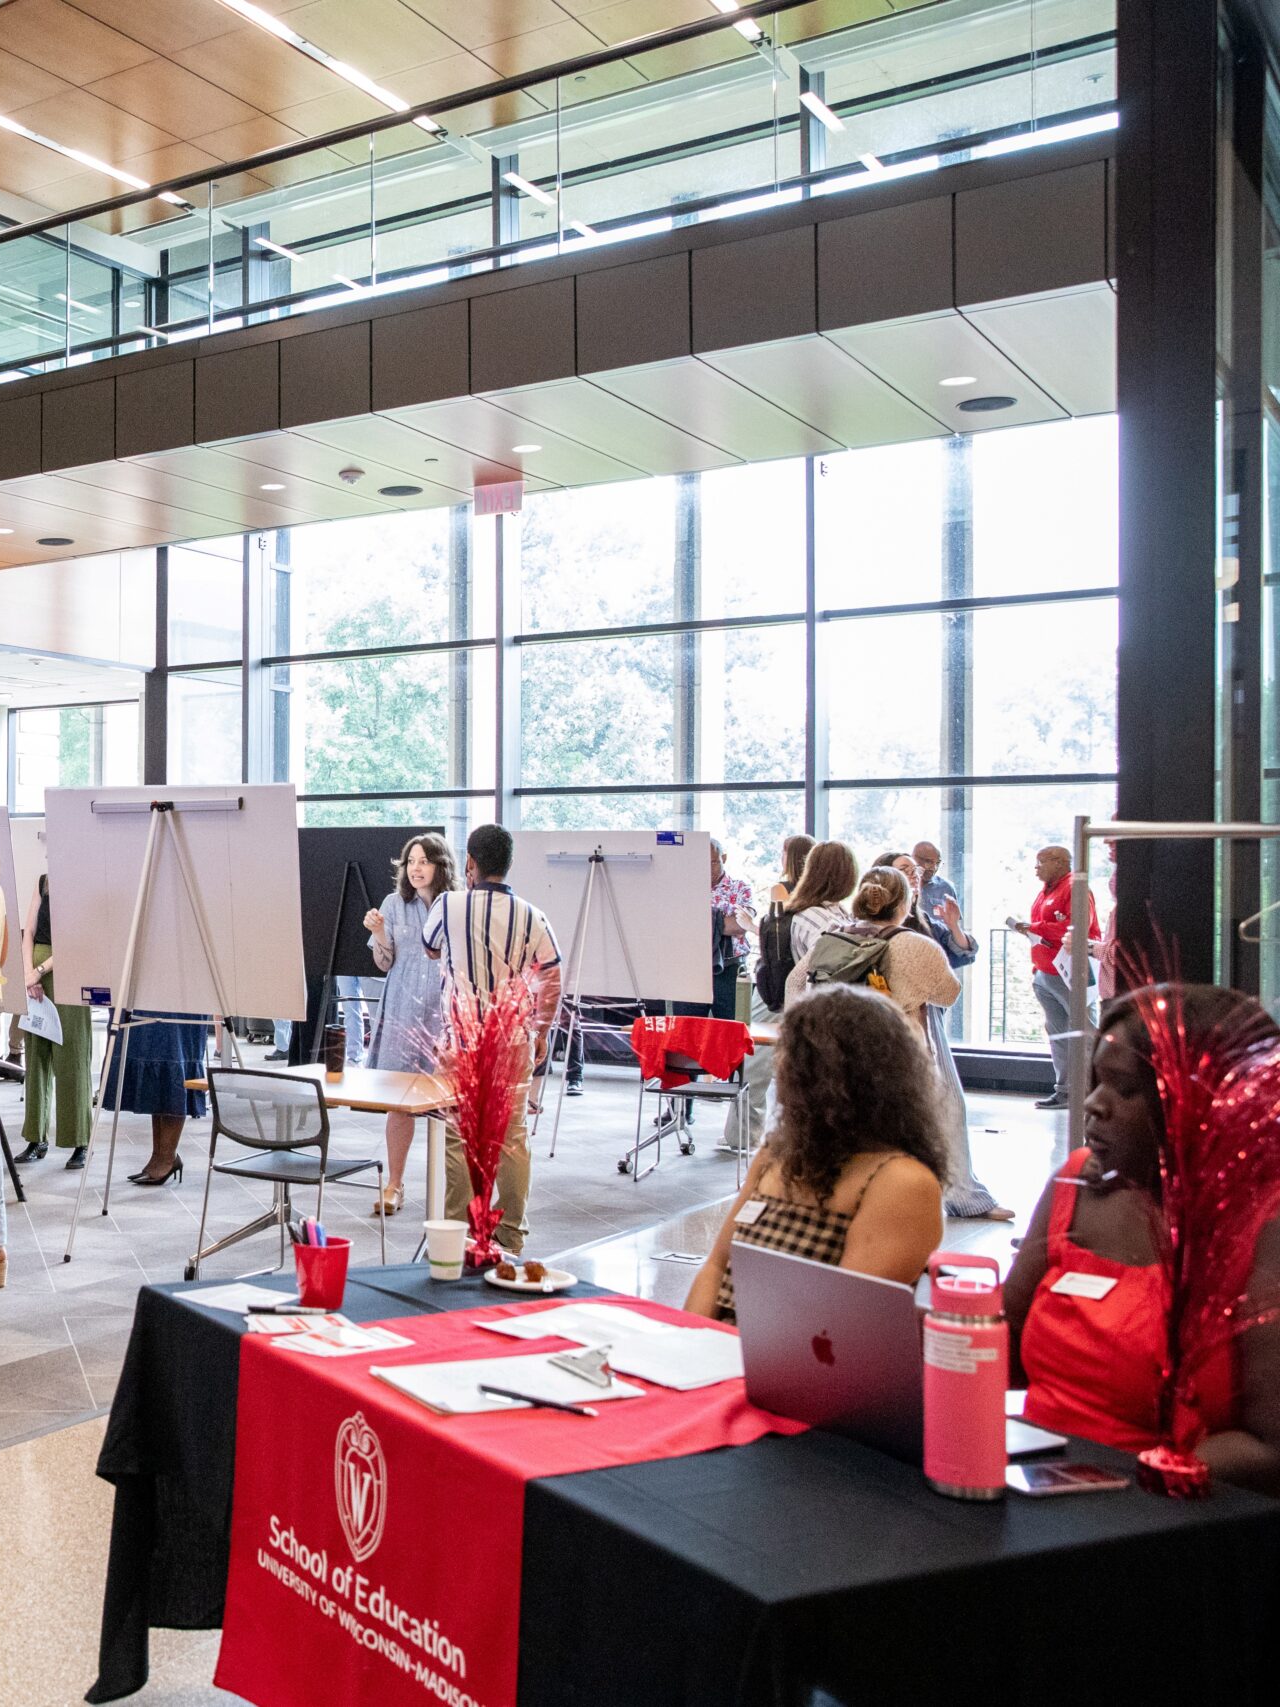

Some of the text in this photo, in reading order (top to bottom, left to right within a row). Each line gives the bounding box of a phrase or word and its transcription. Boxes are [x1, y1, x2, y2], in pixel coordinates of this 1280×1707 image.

[257, 1548, 486, 1707] UNIVERSITY OF WICONSIN-MADISO
[269, 1514, 467, 1679] School of Education
